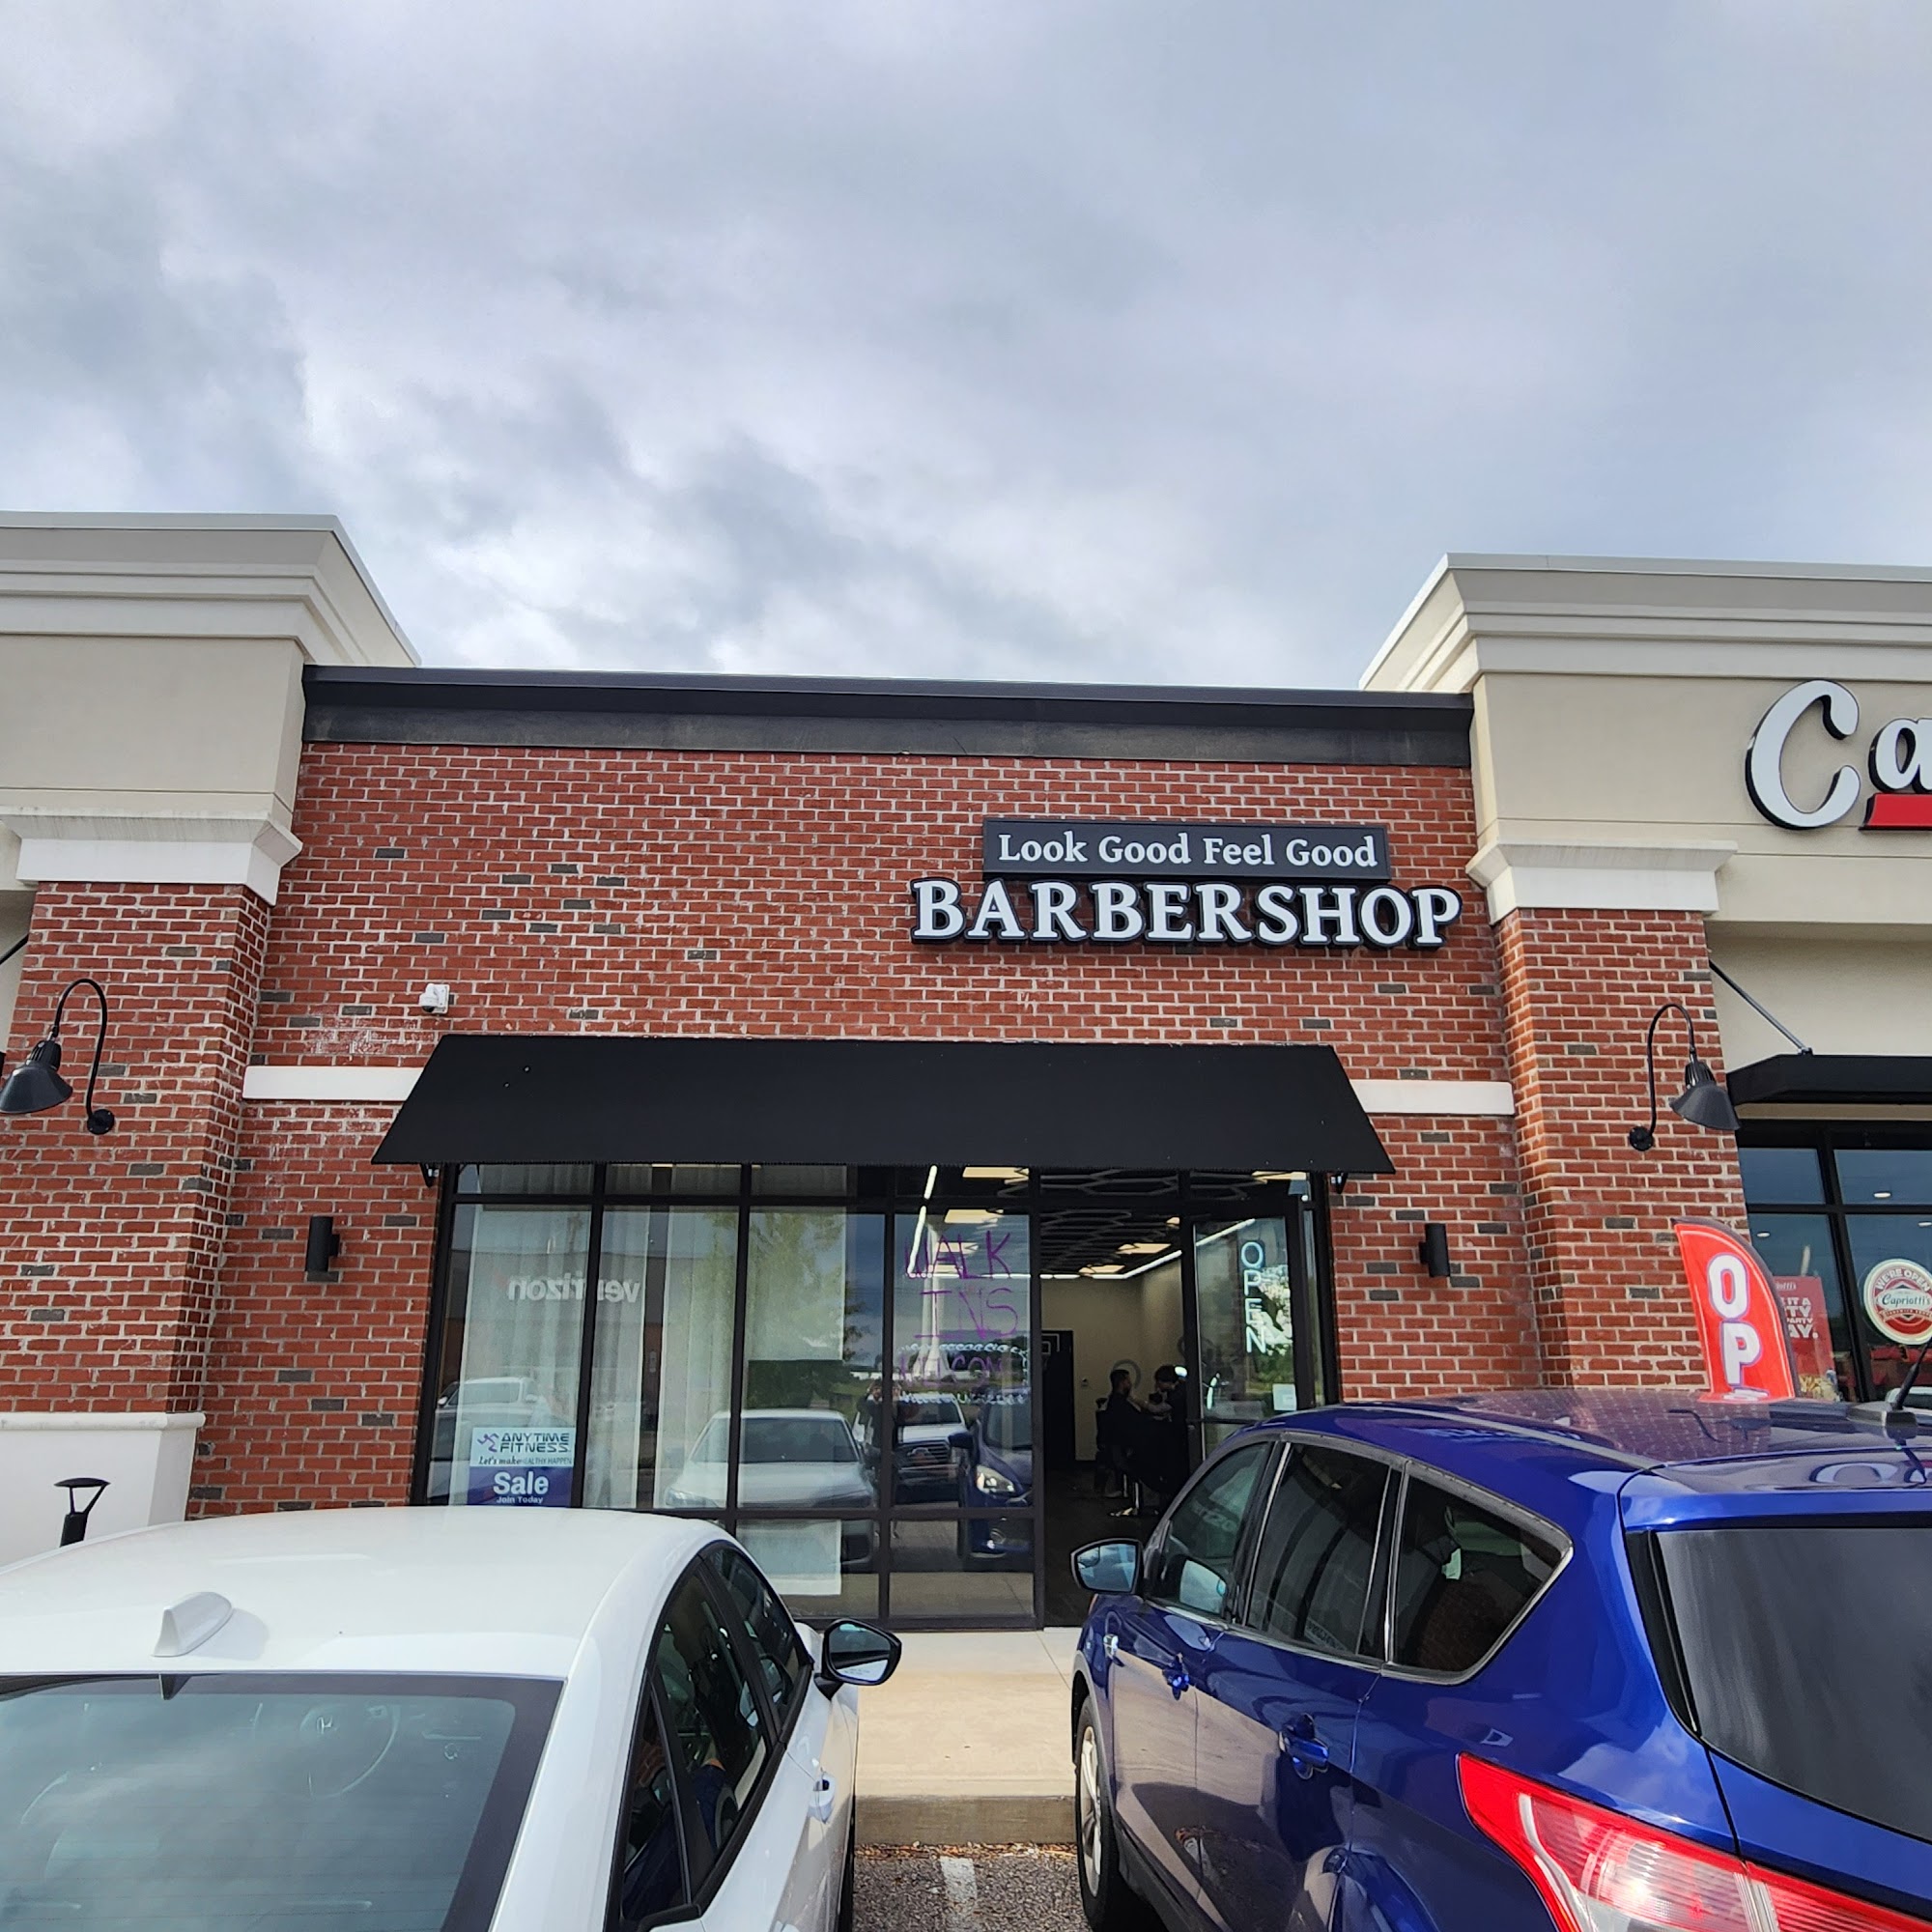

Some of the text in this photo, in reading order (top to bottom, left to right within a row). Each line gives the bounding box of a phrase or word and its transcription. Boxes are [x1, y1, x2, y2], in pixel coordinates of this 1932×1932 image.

[998, 831, 1378, 867] Look Good Feel Good
[912, 878, 1462, 947] BARBERSHOP
[904, 1230, 1011, 1281] WALK
[1904, 1269, 1931, 1292] OPEN
[1240, 1241, 1267, 1353] OPEN
[1882, 1293, 1931, 1307] Capriotti's
[913, 1287, 1018, 1340] INS
[1785, 1306, 1811, 1317] TY
[499, 1442, 569, 1453] FITNESS
[501, 1433, 570, 1442] ANYTIME
[478, 1456, 497, 1464] Let's
[498, 1456, 521, 1464] make
[493, 1470, 549, 1495] Sale
[518, 1496, 544, 1505] Today
